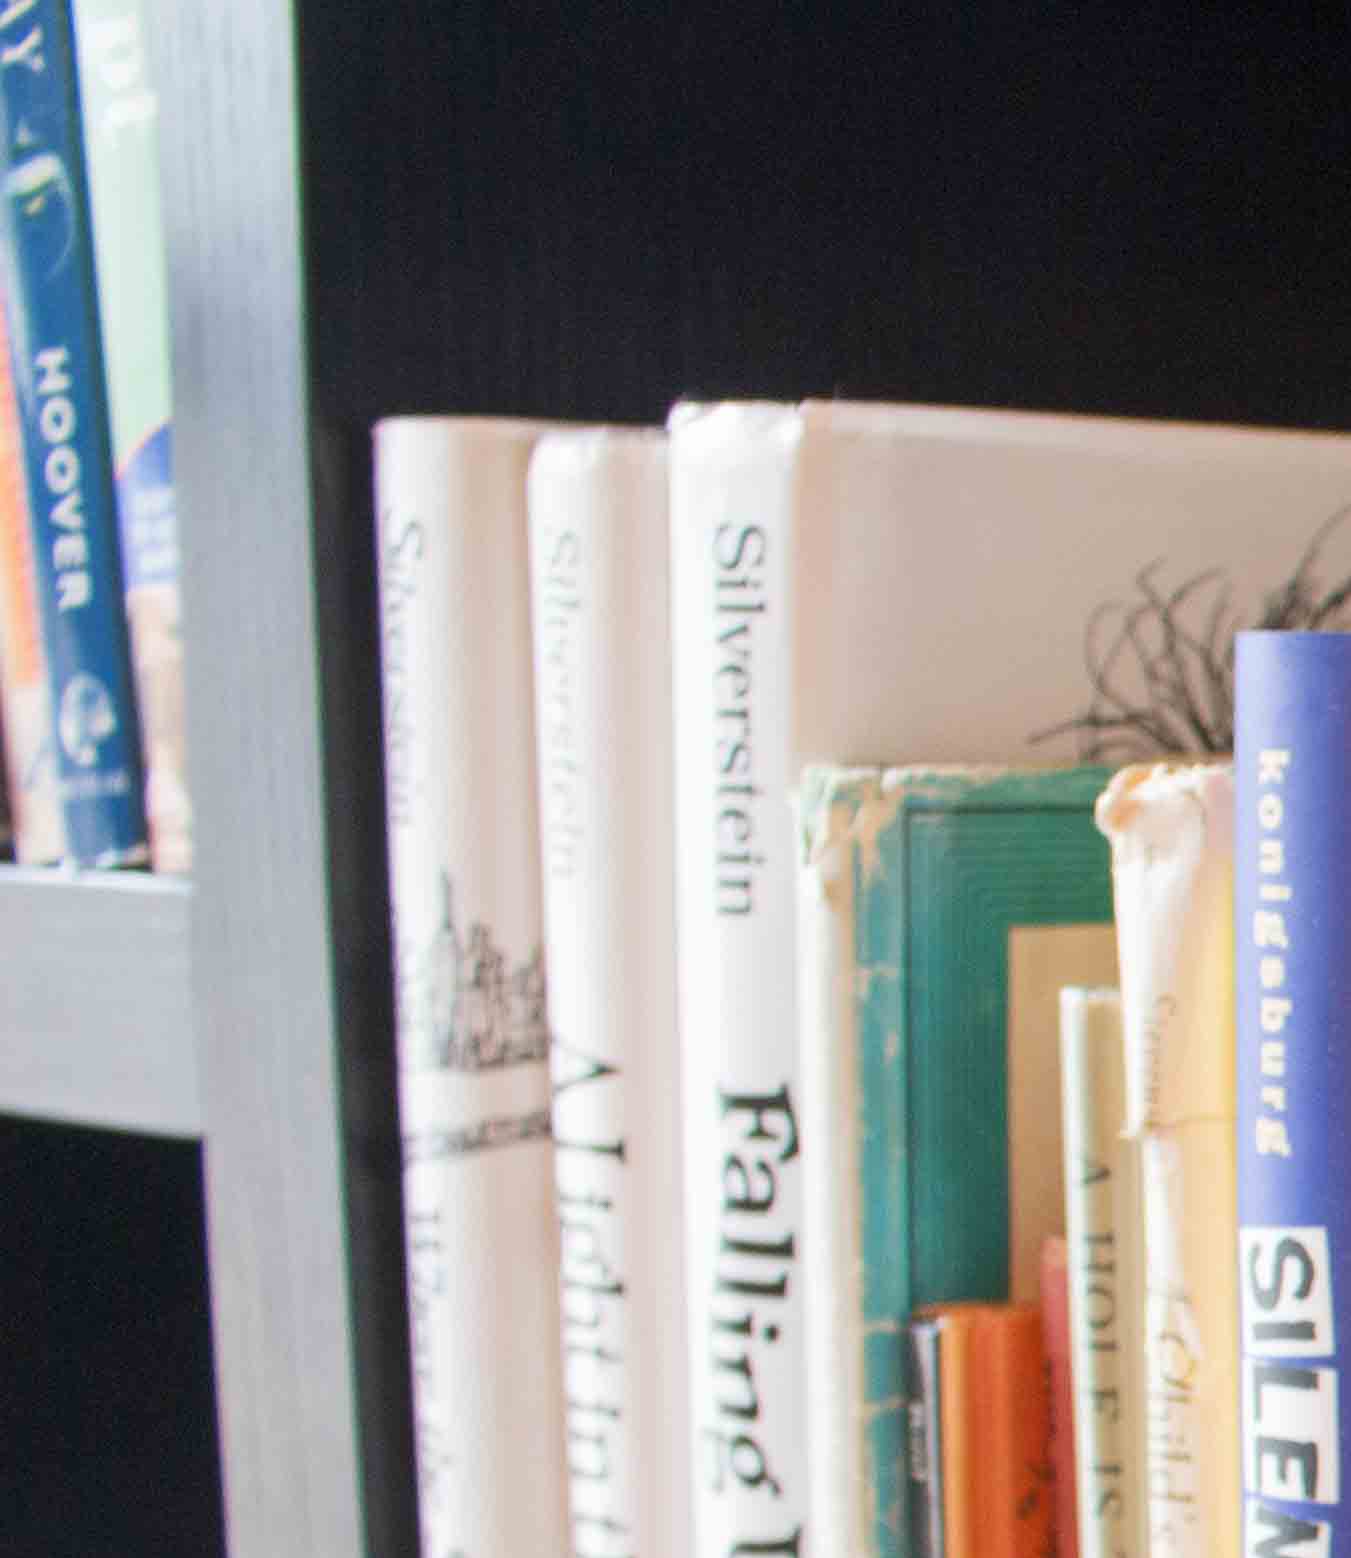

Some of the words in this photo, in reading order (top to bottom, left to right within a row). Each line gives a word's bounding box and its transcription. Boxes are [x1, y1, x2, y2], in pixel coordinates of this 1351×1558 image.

[35, 346, 94, 611] HOOVER
[714, 522, 768, 918] Silverstein
[1252, 749, 1296, 1160] konigsburg
[703, 1084, 801, 1494] Falling
